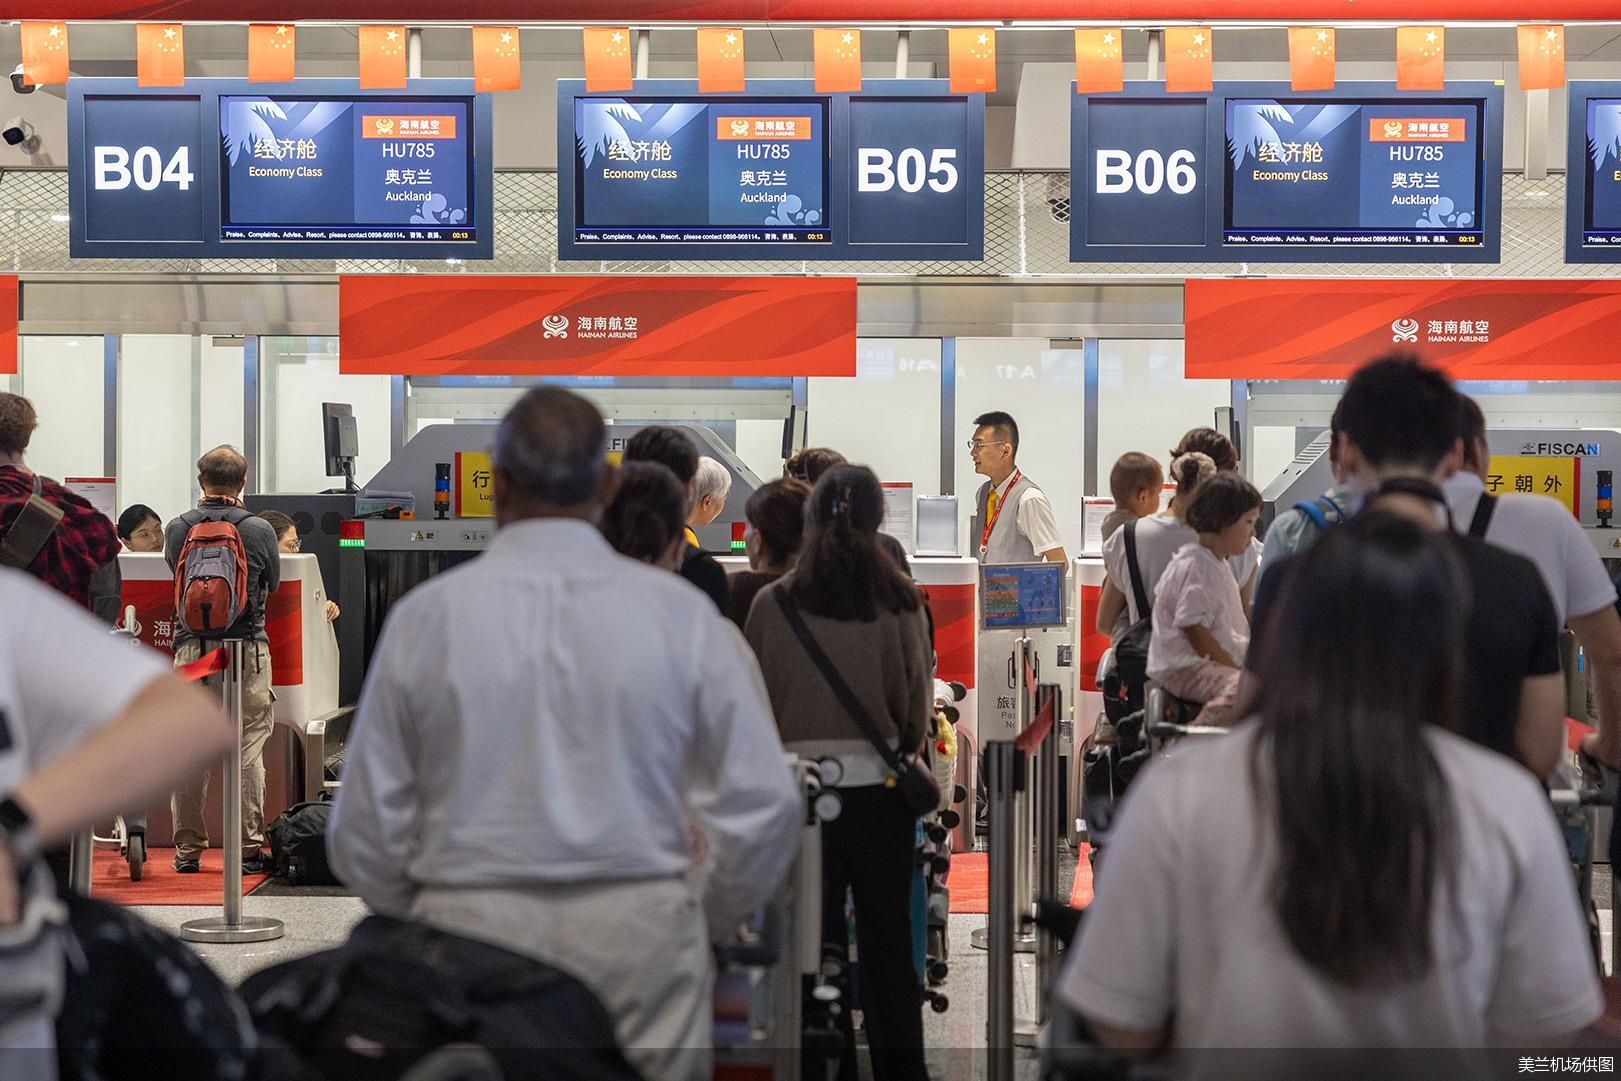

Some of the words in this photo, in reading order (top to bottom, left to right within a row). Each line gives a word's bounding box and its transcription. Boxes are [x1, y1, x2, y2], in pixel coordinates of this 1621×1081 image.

[400, 119, 440, 130] 海南航空
[755, 121, 796, 131] 海南航空
[1408, 123, 1449, 133] 海南航空
[254, 138, 317, 160] 经济舱
[382, 143, 435, 158] HU785
[608, 139, 672, 161] 经济舱
[737, 144, 790, 159] HU785
[1258, 141, 1324, 163] 经济舱
[1389, 145, 1443, 161] HU785
[94, 146, 194, 190] B04
[249, 166, 295, 179] Economy
[297, 166, 322, 177] Class
[603, 168, 650, 181] Economy
[651, 168, 678, 178] Class
[858, 147, 958, 193] B05
[1096, 149, 1197, 195] B06
[385, 168, 432, 185] 奥克兰
[740, 170, 788, 186] 奥克兰
[1253, 170, 1300, 182] Economy
[1301, 170, 1328, 180] Class
[1392, 172, 1440, 189] 奥克兰
[385, 191, 432, 201] Auckland
[740, 192, 787, 203] Auckland
[1392, 194, 1439, 205] Auckland
[1458, 235, 1476, 243] 00:13
[578, 316, 638, 331] 海南航空
[1428, 320, 1488, 334] 海南航空
[1538, 443, 1600, 456] FISCAN
